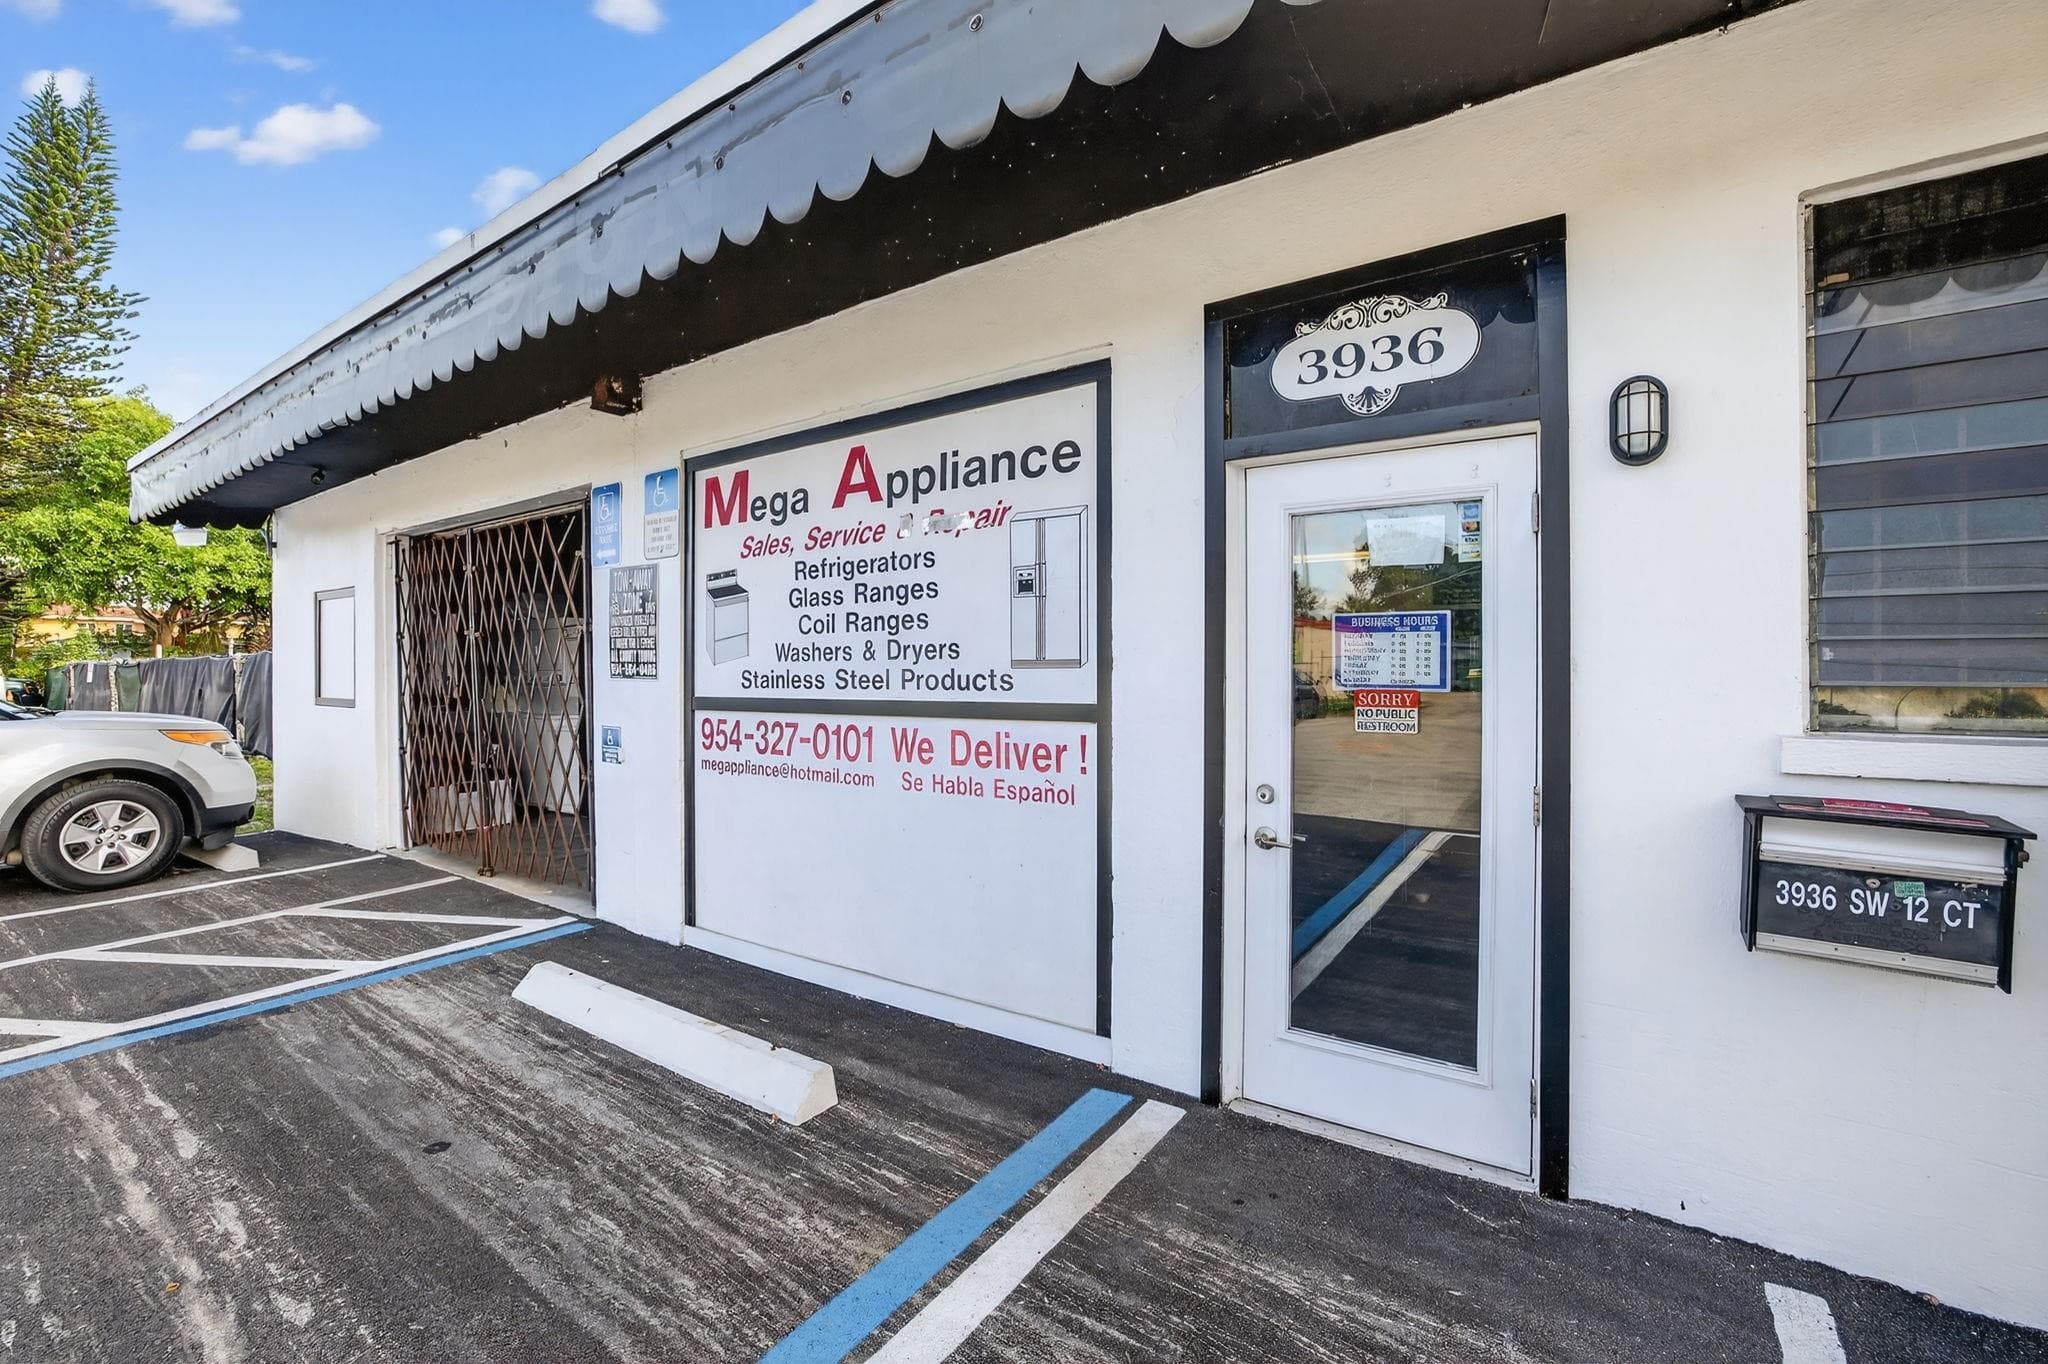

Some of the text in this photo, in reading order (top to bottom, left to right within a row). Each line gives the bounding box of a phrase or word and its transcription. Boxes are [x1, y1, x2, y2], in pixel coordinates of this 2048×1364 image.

[1297, 326, 1444, 385] 3936
[704, 440, 1082, 529] Mega Appliance
[740, 533, 794, 559] Sales,
[804, 521, 886, 551] Service
[794, 550, 936, 581] Refrigerators
[789, 581, 939, 609] Glass Ranges
[799, 612, 929, 636] Coil Ranges
[1351, 615, 1439, 627] BUSINESS HOURS
[775, 640, 960, 664] Washers & Dryers
[741, 668, 1014, 692] Stainless Steel Products
[1357, 708, 1416, 719] NO PUBLIC
[1358, 692, 1415, 706] SORRY
[701, 717, 874, 763] 954-327-0101
[1356, 720, 1416, 732] RESTROOM
[891, 727, 935, 765] We
[950, 729, 1068, 774] Deliver
[701, 758, 875, 788] megappliance@hotmail.com
[901, 772, 1076, 806] Se Habla Español
[1775, 879, 1838, 912] 3936
[1849, 888, 1890, 918] SW
[1902, 896, 1929, 924] 12
[1943, 900, 1982, 929] CT
